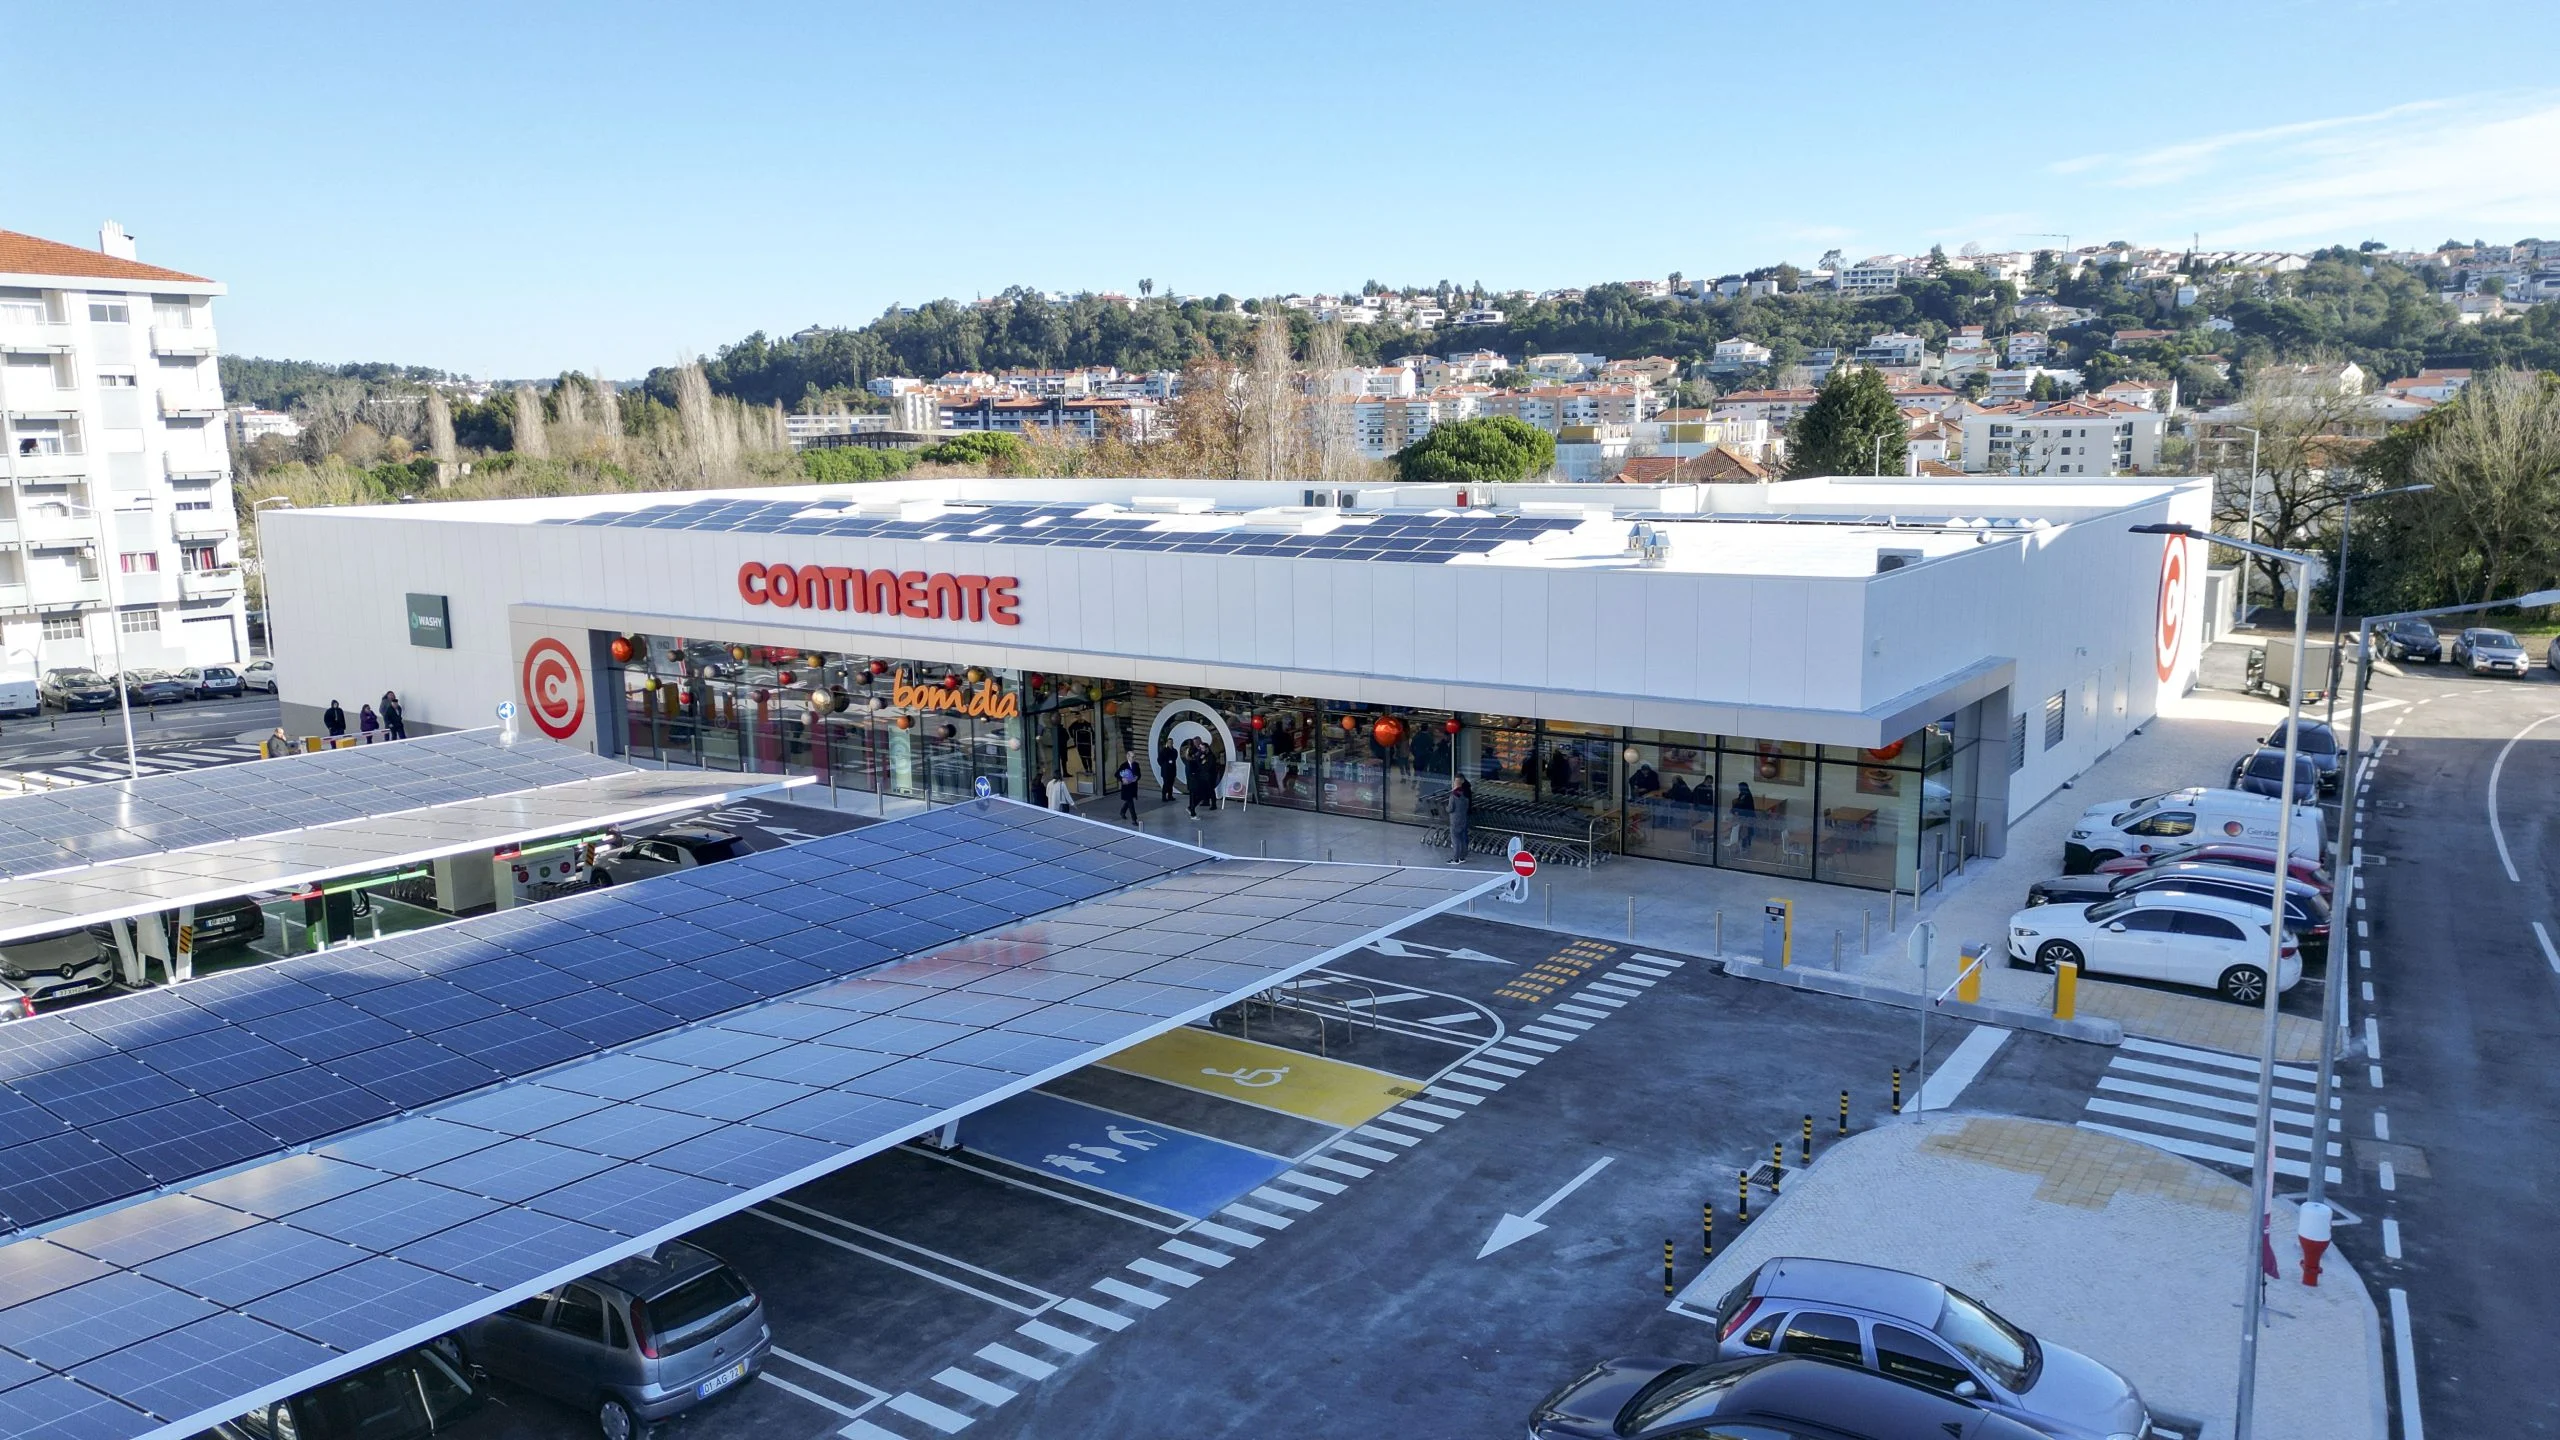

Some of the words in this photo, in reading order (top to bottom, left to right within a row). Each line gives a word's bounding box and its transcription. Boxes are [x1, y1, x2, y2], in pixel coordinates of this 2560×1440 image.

[738, 562, 1019, 625] CONTINENTE
[418, 615, 442, 628] WASHY
[893, 668, 967, 714] bom
[968, 678, 1019, 719] dia
